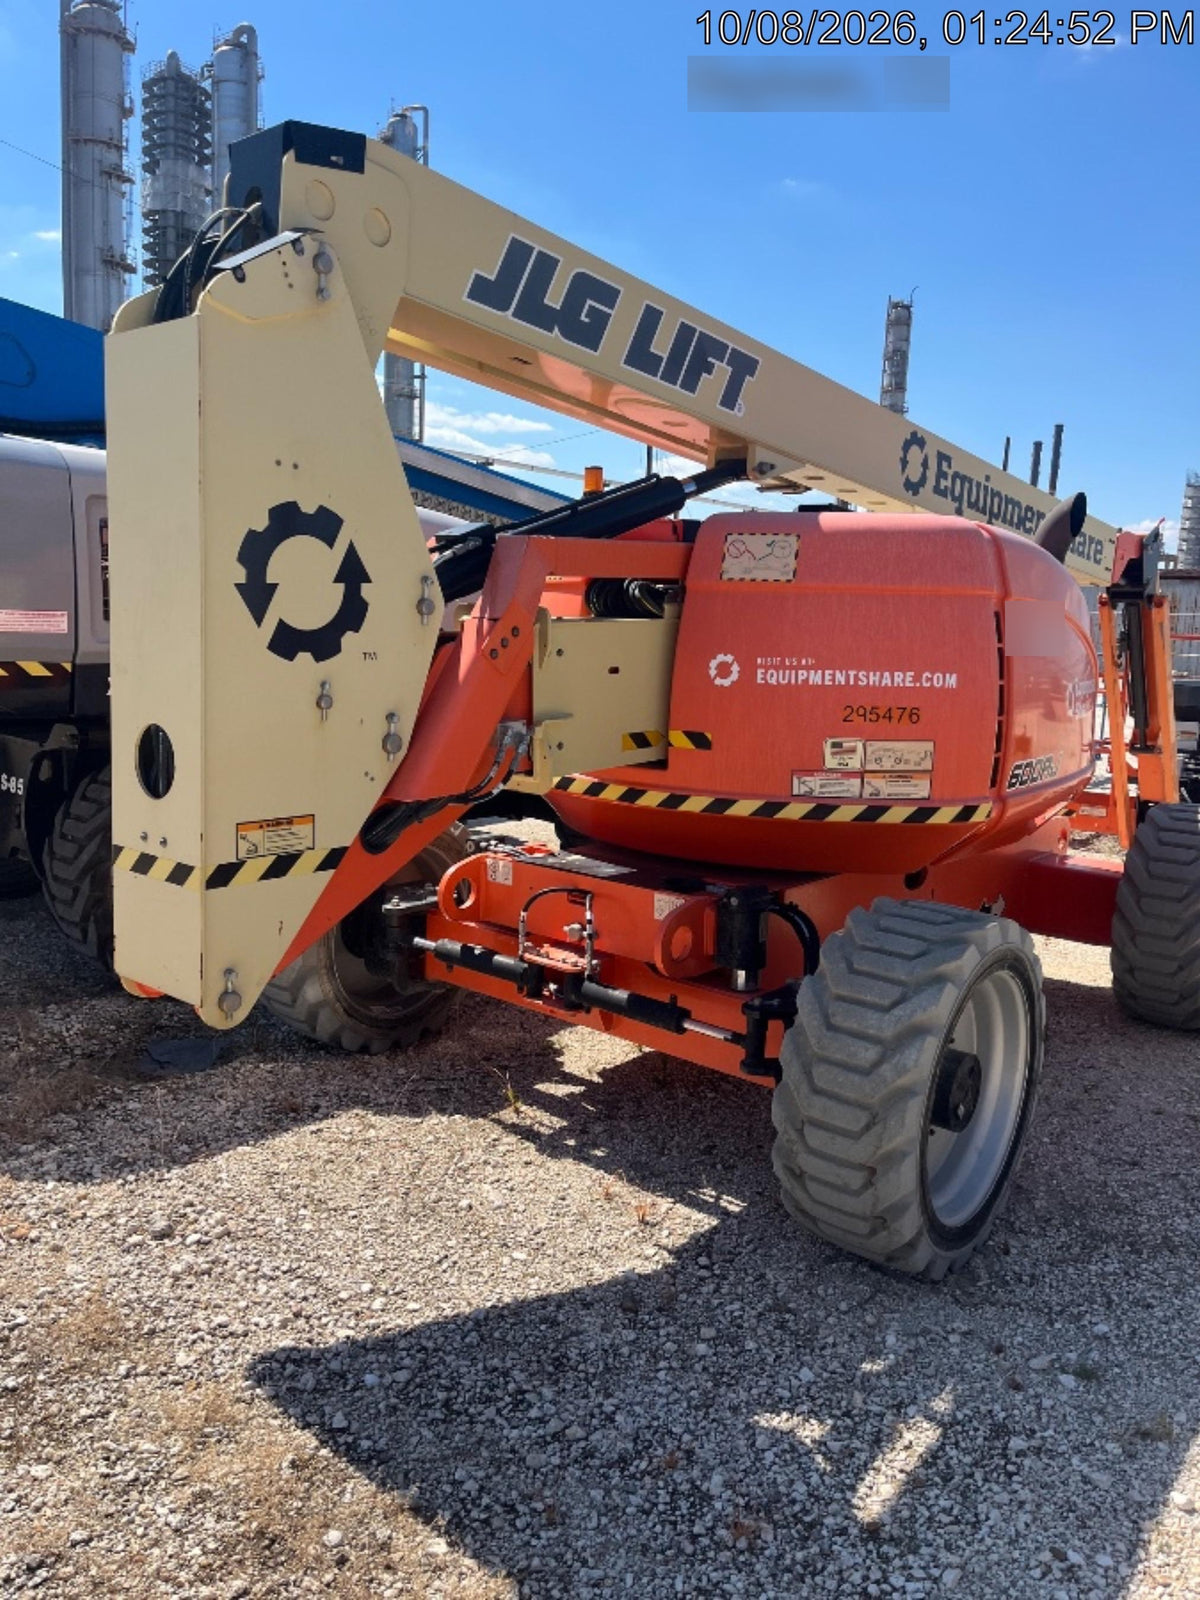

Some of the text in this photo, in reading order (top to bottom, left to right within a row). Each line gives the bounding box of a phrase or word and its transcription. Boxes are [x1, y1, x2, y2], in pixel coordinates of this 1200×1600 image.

[463, 233, 761, 412] JLG LIFT
[757, 669, 957, 688] EQUIPMENTSHARE.COM
[842, 705, 921, 725] 295476
[1, 773, 24, 795] S-85
